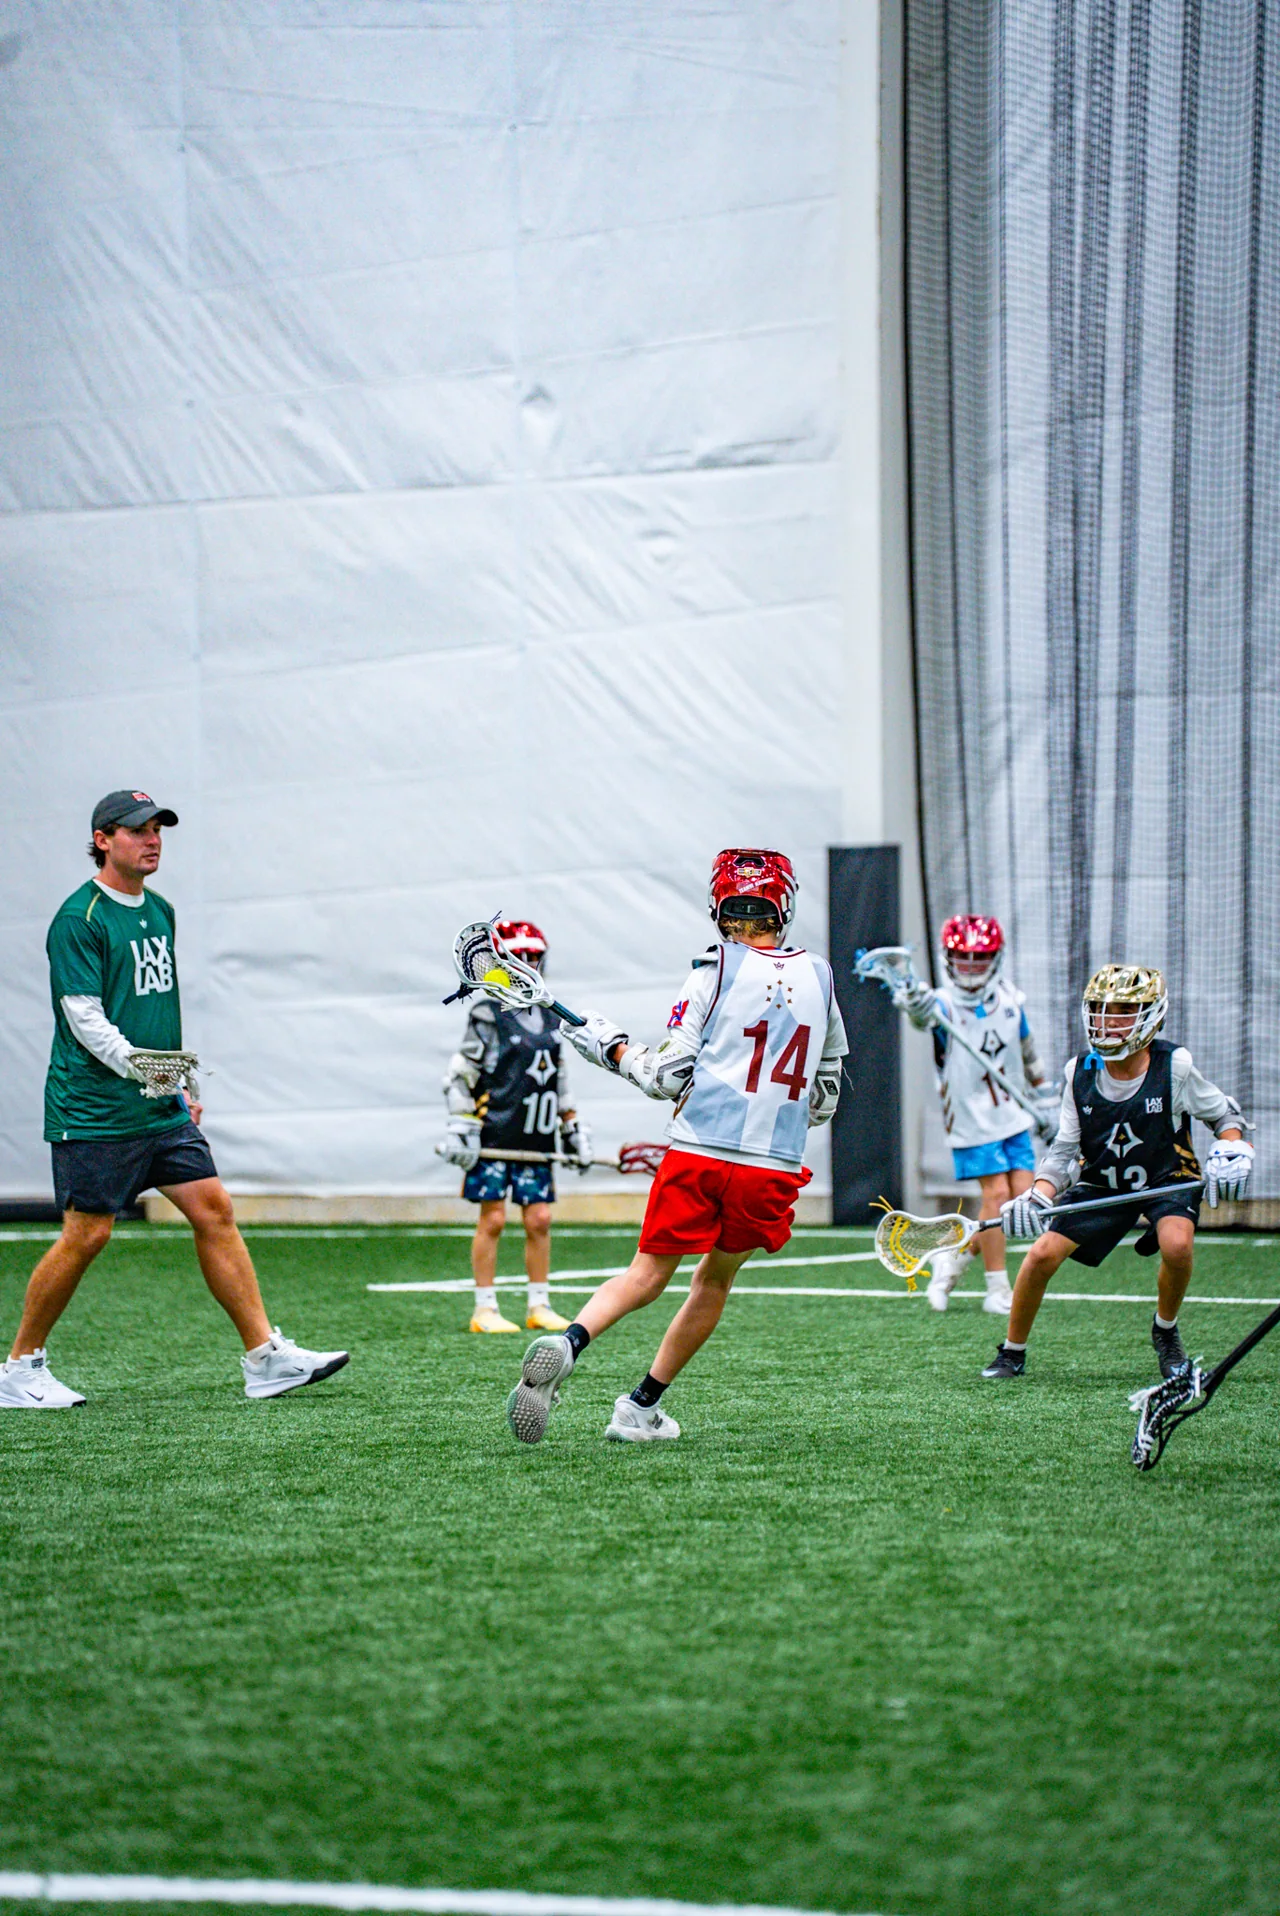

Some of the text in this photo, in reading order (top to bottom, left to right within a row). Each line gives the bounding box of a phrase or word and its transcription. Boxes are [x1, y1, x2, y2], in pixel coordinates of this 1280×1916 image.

[130, 935, 172, 968] LAX
[134, 963, 173, 996] LAB
[743, 1019, 811, 1102] 14
[522, 1090, 557, 1134] 10
[1145, 1097, 1163, 1106] LAX
[1146, 1104, 1163, 1114] LAB
